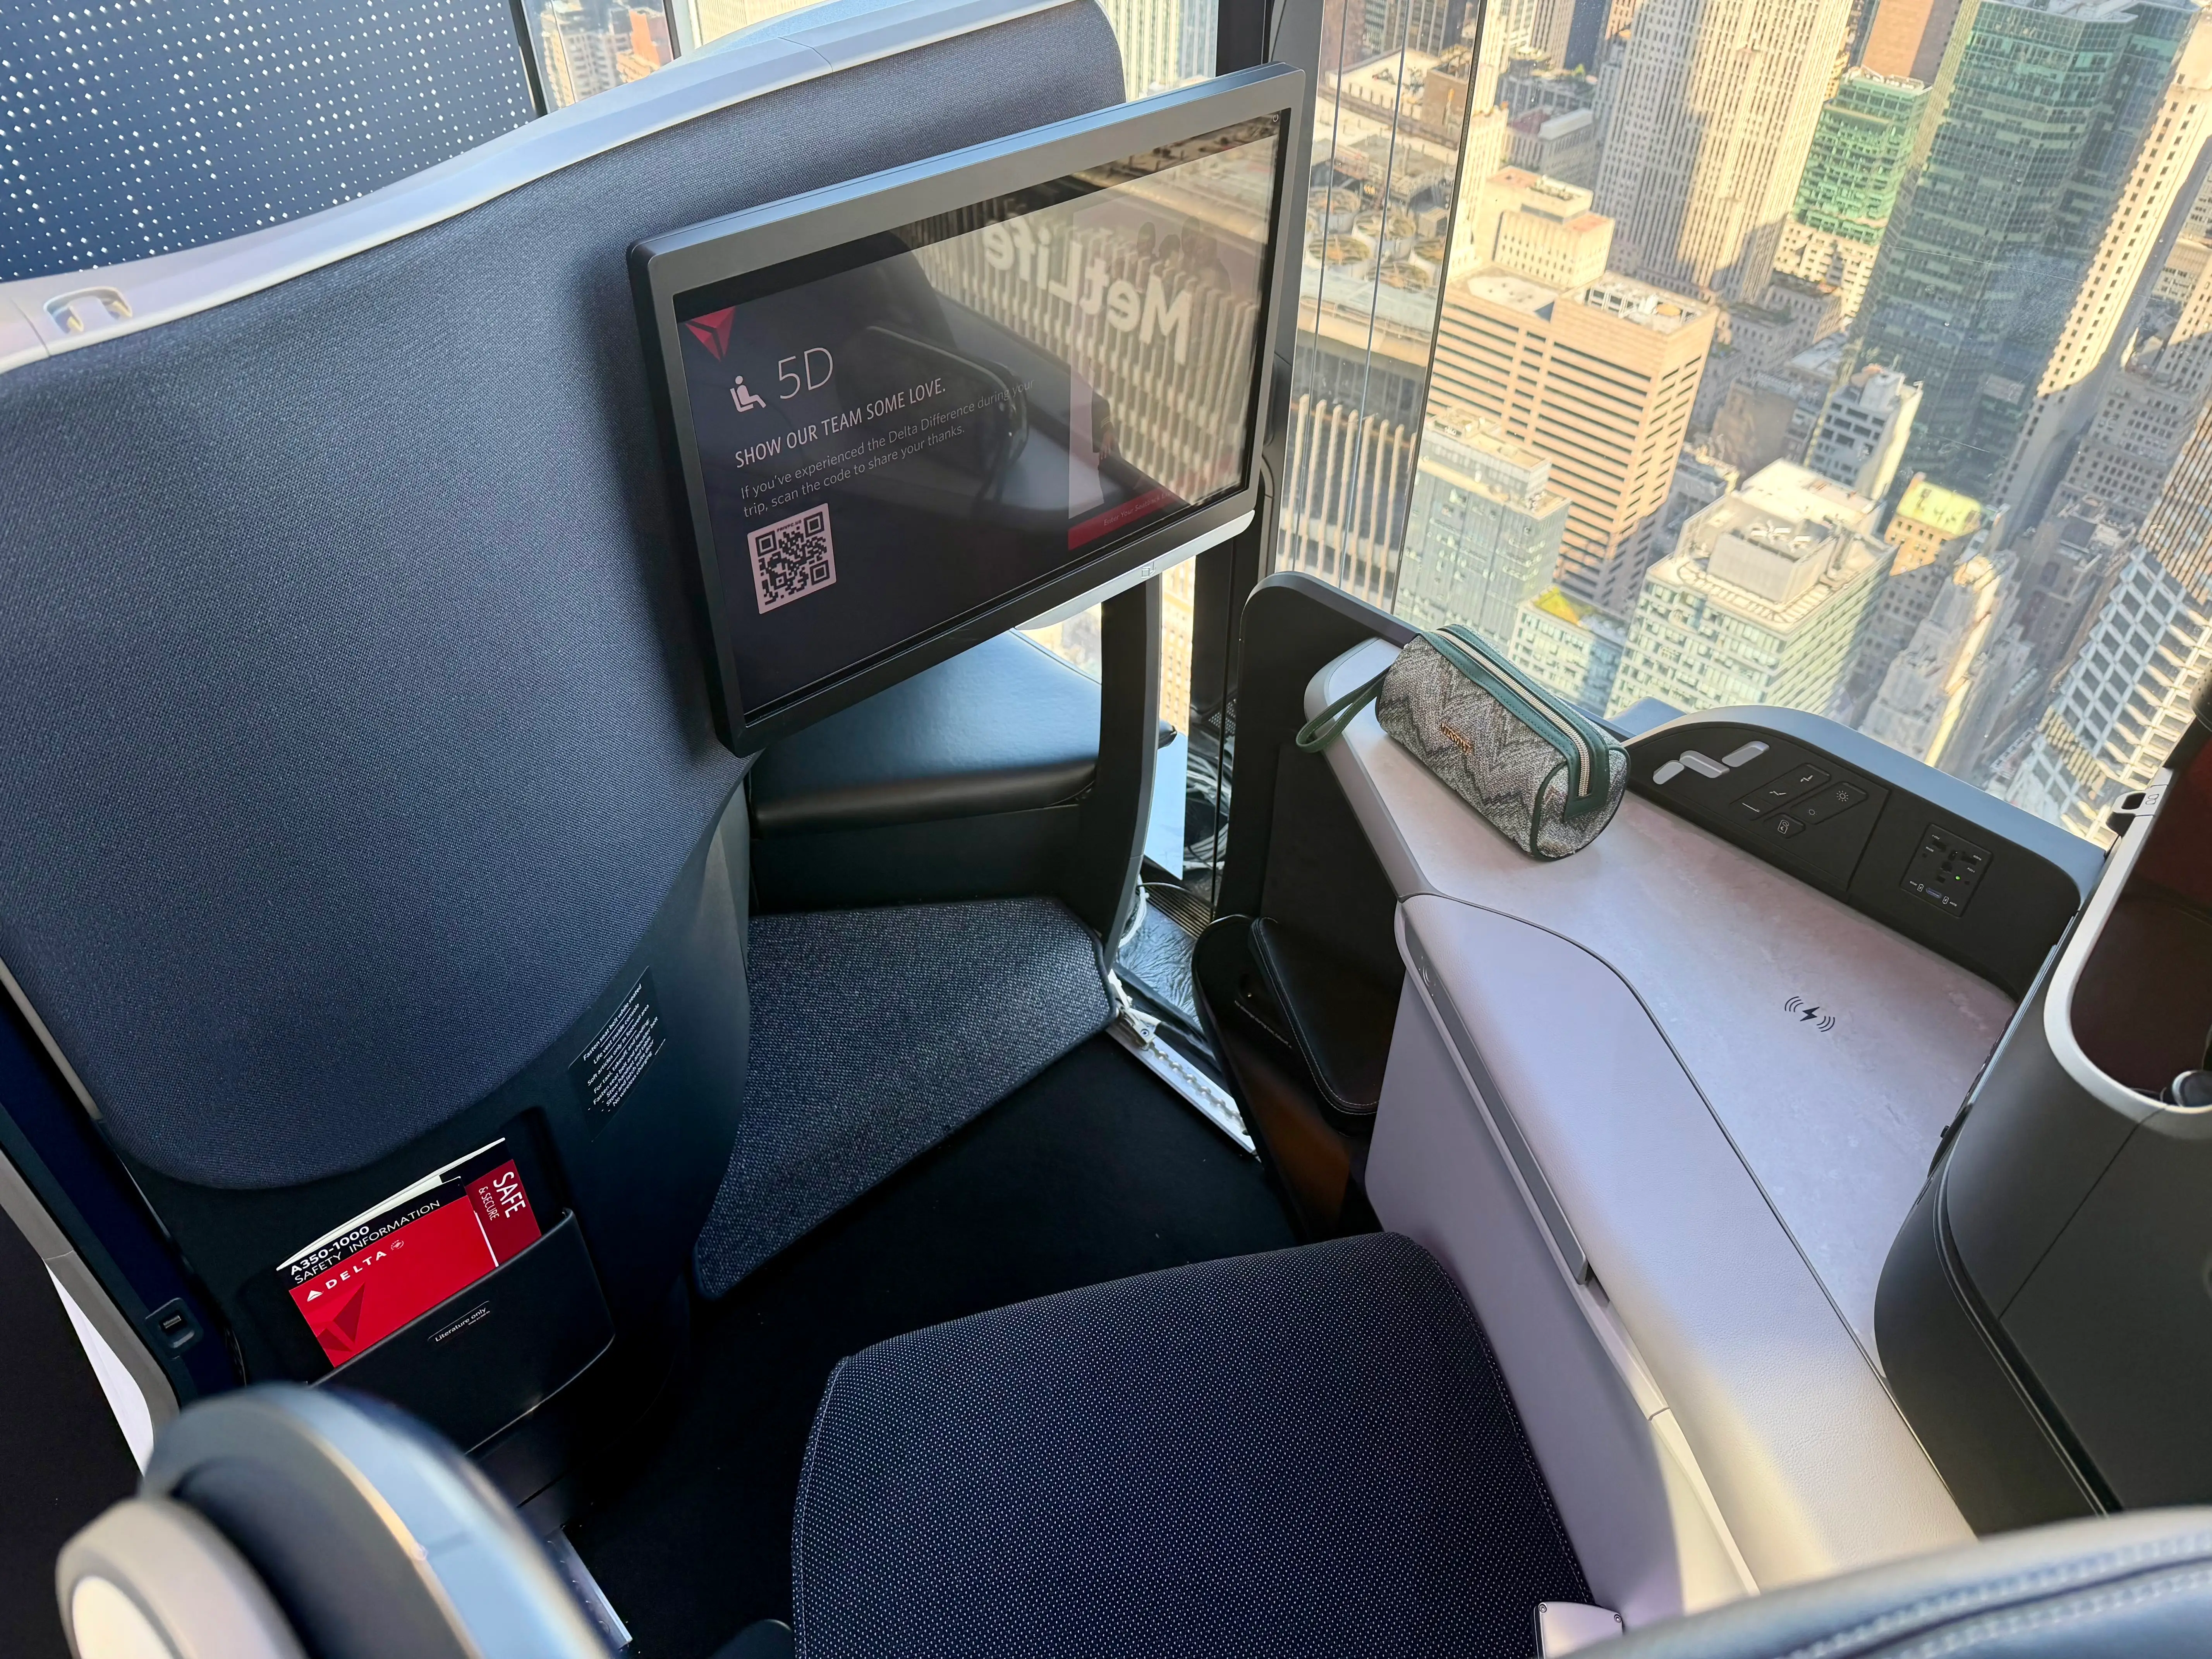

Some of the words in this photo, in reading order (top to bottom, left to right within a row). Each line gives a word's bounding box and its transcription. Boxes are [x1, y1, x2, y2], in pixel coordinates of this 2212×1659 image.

[778, 347, 833, 399] 5D
[735, 436, 781, 468] SHOW
[786, 424, 818, 448] OUR
[821, 407, 862, 436] TEAM
[866, 391, 905, 420] SOME
[909, 378, 945, 404] LOVE.
[741, 485, 749, 499] If
[795, 442, 864, 478] experienced
[867, 438, 885, 451] the
[888, 425, 917, 443] Delta
[921, 403, 974, 431] Difference
[977, 388, 1009, 410] during
[1012, 379, 1034, 401] your
[744, 502, 768, 517] trip,
[771, 489, 798, 507] scan
[801, 481, 820, 495] the
[823, 469, 850, 486] code
[854, 464, 865, 475] to
[868, 451, 898, 469] share
[900, 440, 925, 459] your
[927, 426, 964, 446] thanks.
[583, 1041, 600, 1061] Fasten
[599, 1028, 610, 1042] seat
[608, 1017, 618, 1030] belt
[617, 1002, 629, 1018] while
[628, 983, 642, 1004] seated
[587, 1073, 598, 1086] Soft
[597, 1054, 613, 1075] articles
[613, 1042, 622, 1055] only
[626, 1014, 641, 1037] footwell
[641, 1004, 649, 1017] area
[593, 1052, 603, 1064] Life
[602, 1039, 613, 1053] vest
[611, 1024, 625, 1041] inside
[624, 1003, 639, 1025] console
[593, 1082, 602, 1094] For
[602, 1070, 613, 1084] taxi,
[612, 1049, 628, 1071] takeoff,
[634, 1018, 650, 1041] landing:
[593, 1085, 610, 1105] Fasten
[609, 1072, 619, 1086] seat
[618, 1061, 627, 1074] belt
[634, 1027, 650, 1052] shoulder
[650, 1016, 658, 1029] belt
[606, 1082, 618, 1098] Stow
[618, 1060, 634, 1084] handset
[641, 1036, 651, 1051] table
[606, 1090, 618, 1106] Stow
[618, 1079, 626, 1092] and
[625, 1066, 636, 1081] latch
[635, 1053, 645, 1067] suite
[645, 1039, 654, 1053] door
[612, 1096, 620, 1106] No
[619, 1074, 637, 1097] wireless
[636, 1051, 652, 1075] charging
[479, 1186, 488, 1195] &
[481, 1192, 500, 1221] SECURE
[493, 1171, 526, 1218] SAFE
[291, 1226, 369, 1276] A350-1000
[295, 1252, 342, 1284] SAFETY
[349, 1200, 440, 1253] INFORMATION
[325, 1251, 387, 1289] DELTA
[435, 1318, 469, 1342] Literature
[471, 1307, 486, 1319] only
